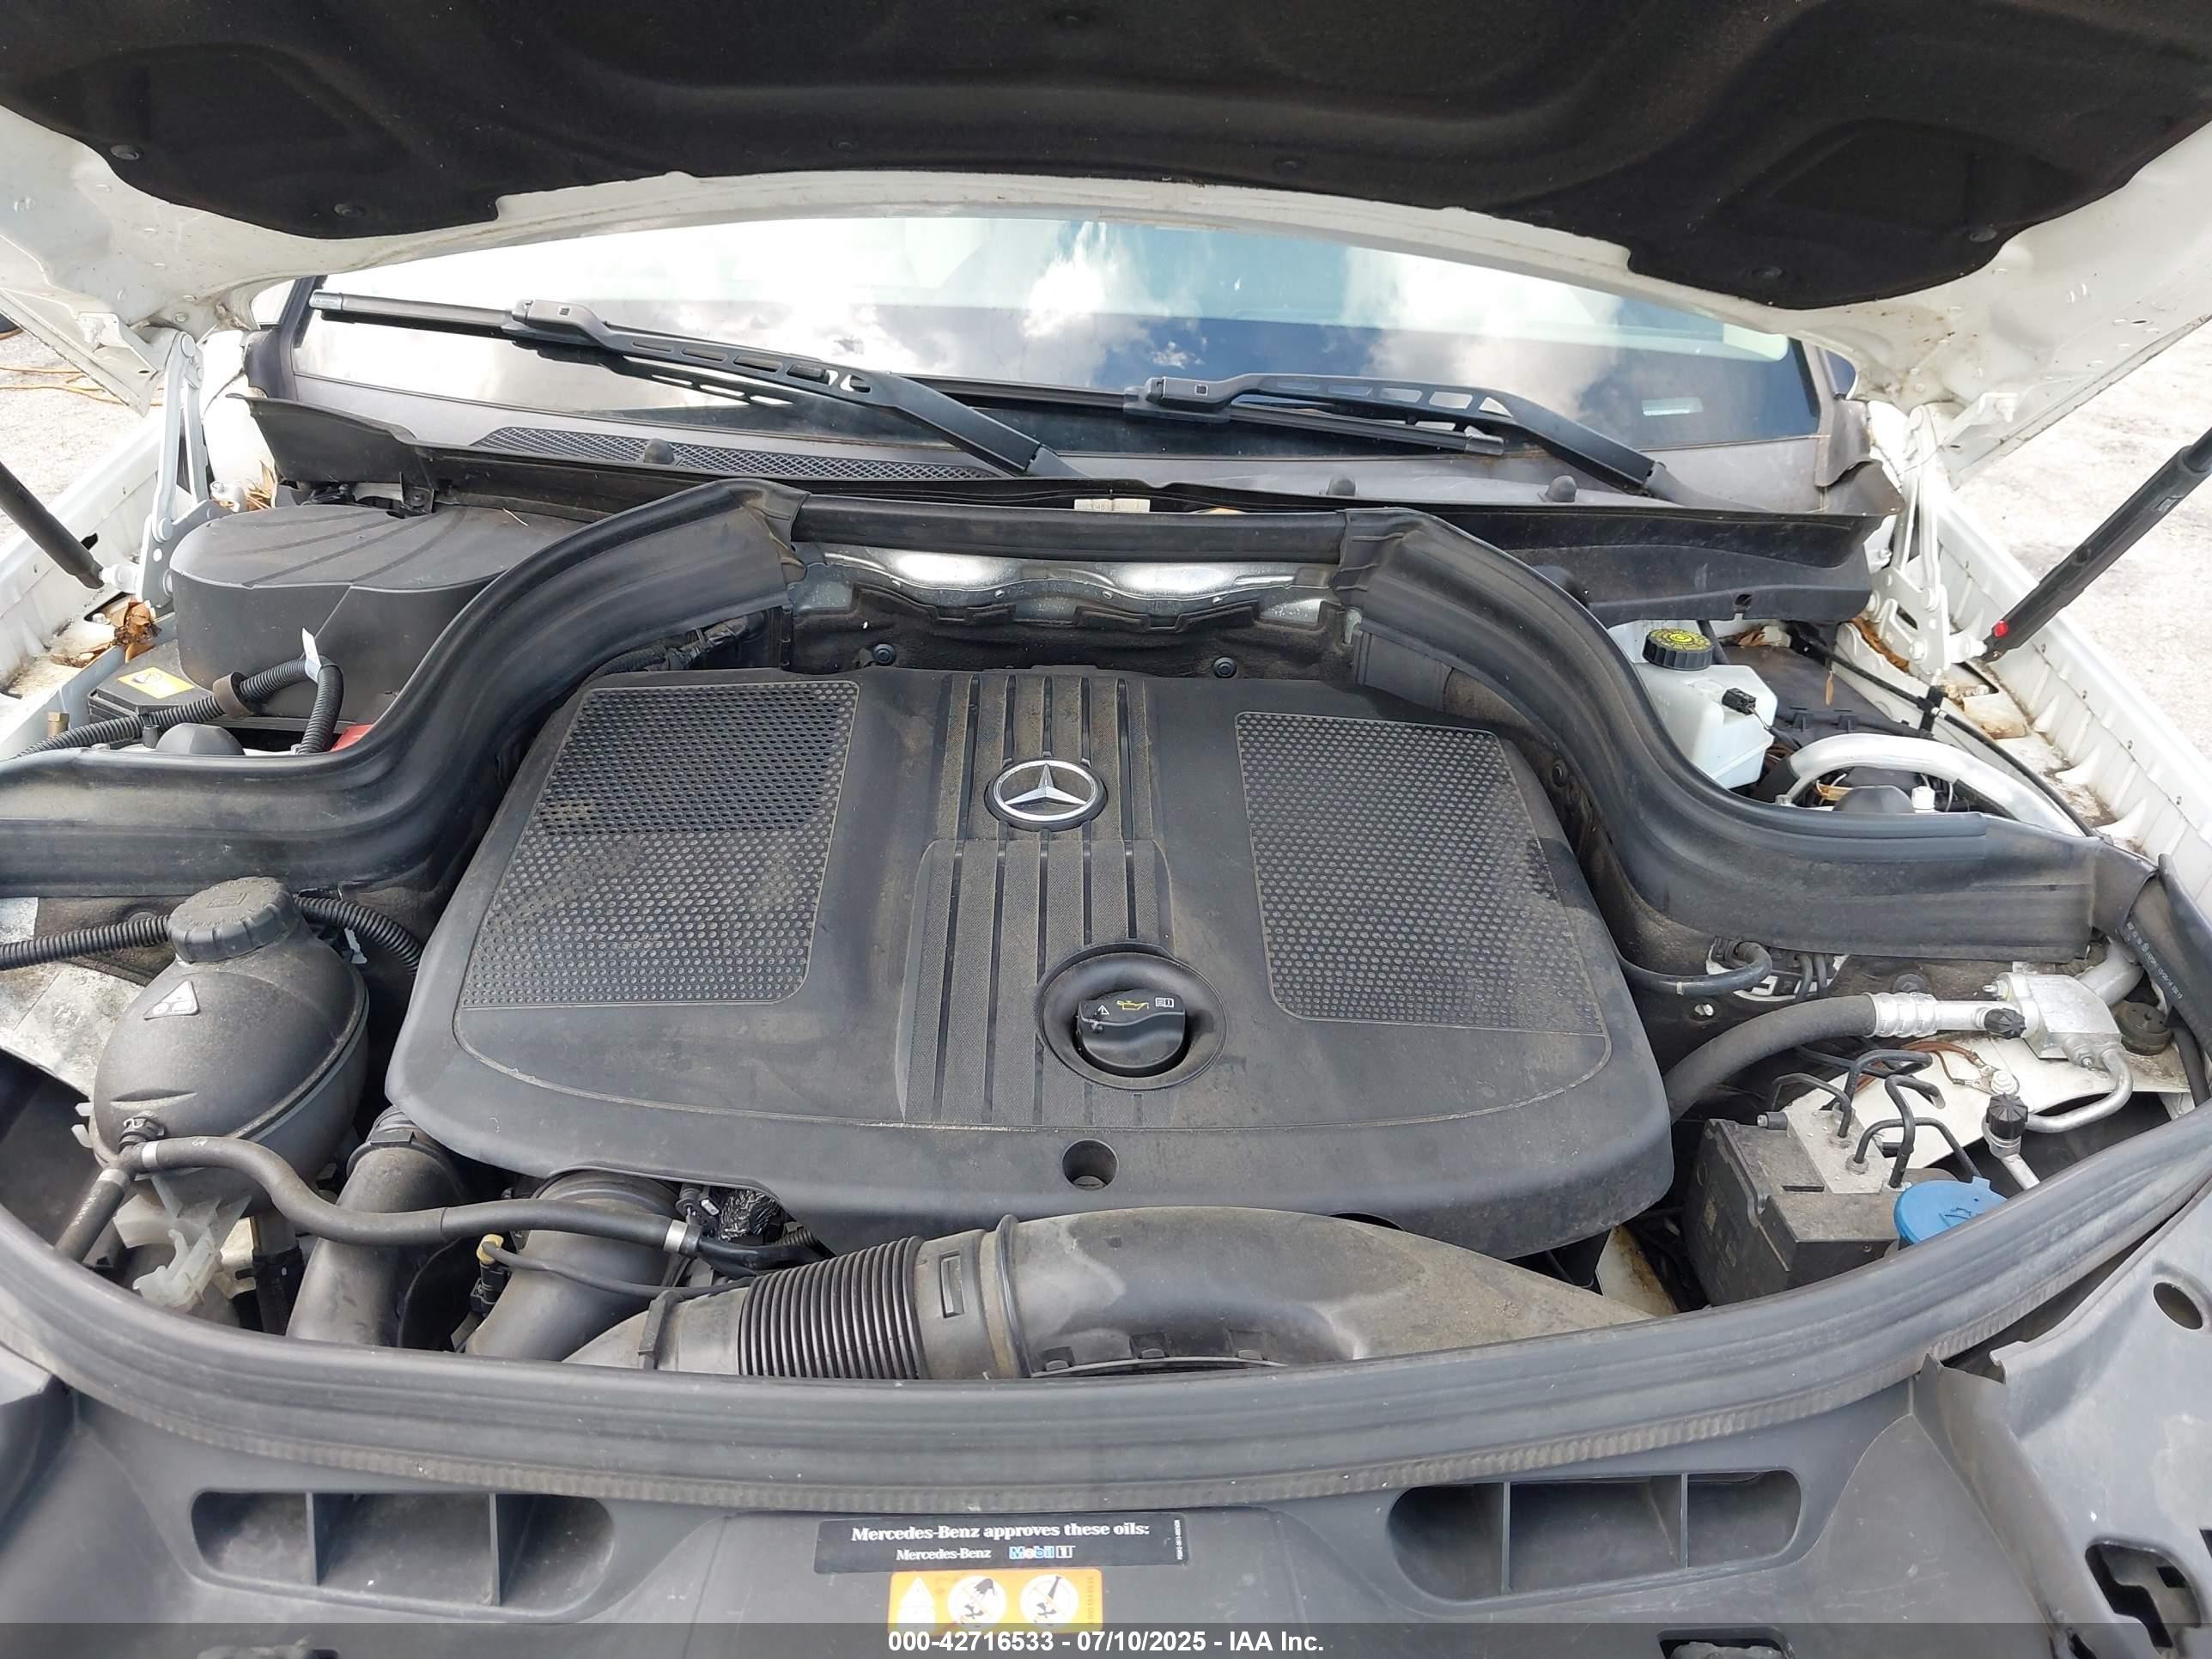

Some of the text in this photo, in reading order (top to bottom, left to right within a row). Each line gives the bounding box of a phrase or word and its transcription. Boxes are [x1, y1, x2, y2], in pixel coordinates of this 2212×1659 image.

[851, 1522, 1150, 1541] Mercedes-Benz approves these oils:
[896, 1547, 992, 1560] Mercedes-Benz
[1008, 1546, 1054, 1559] Mobil
